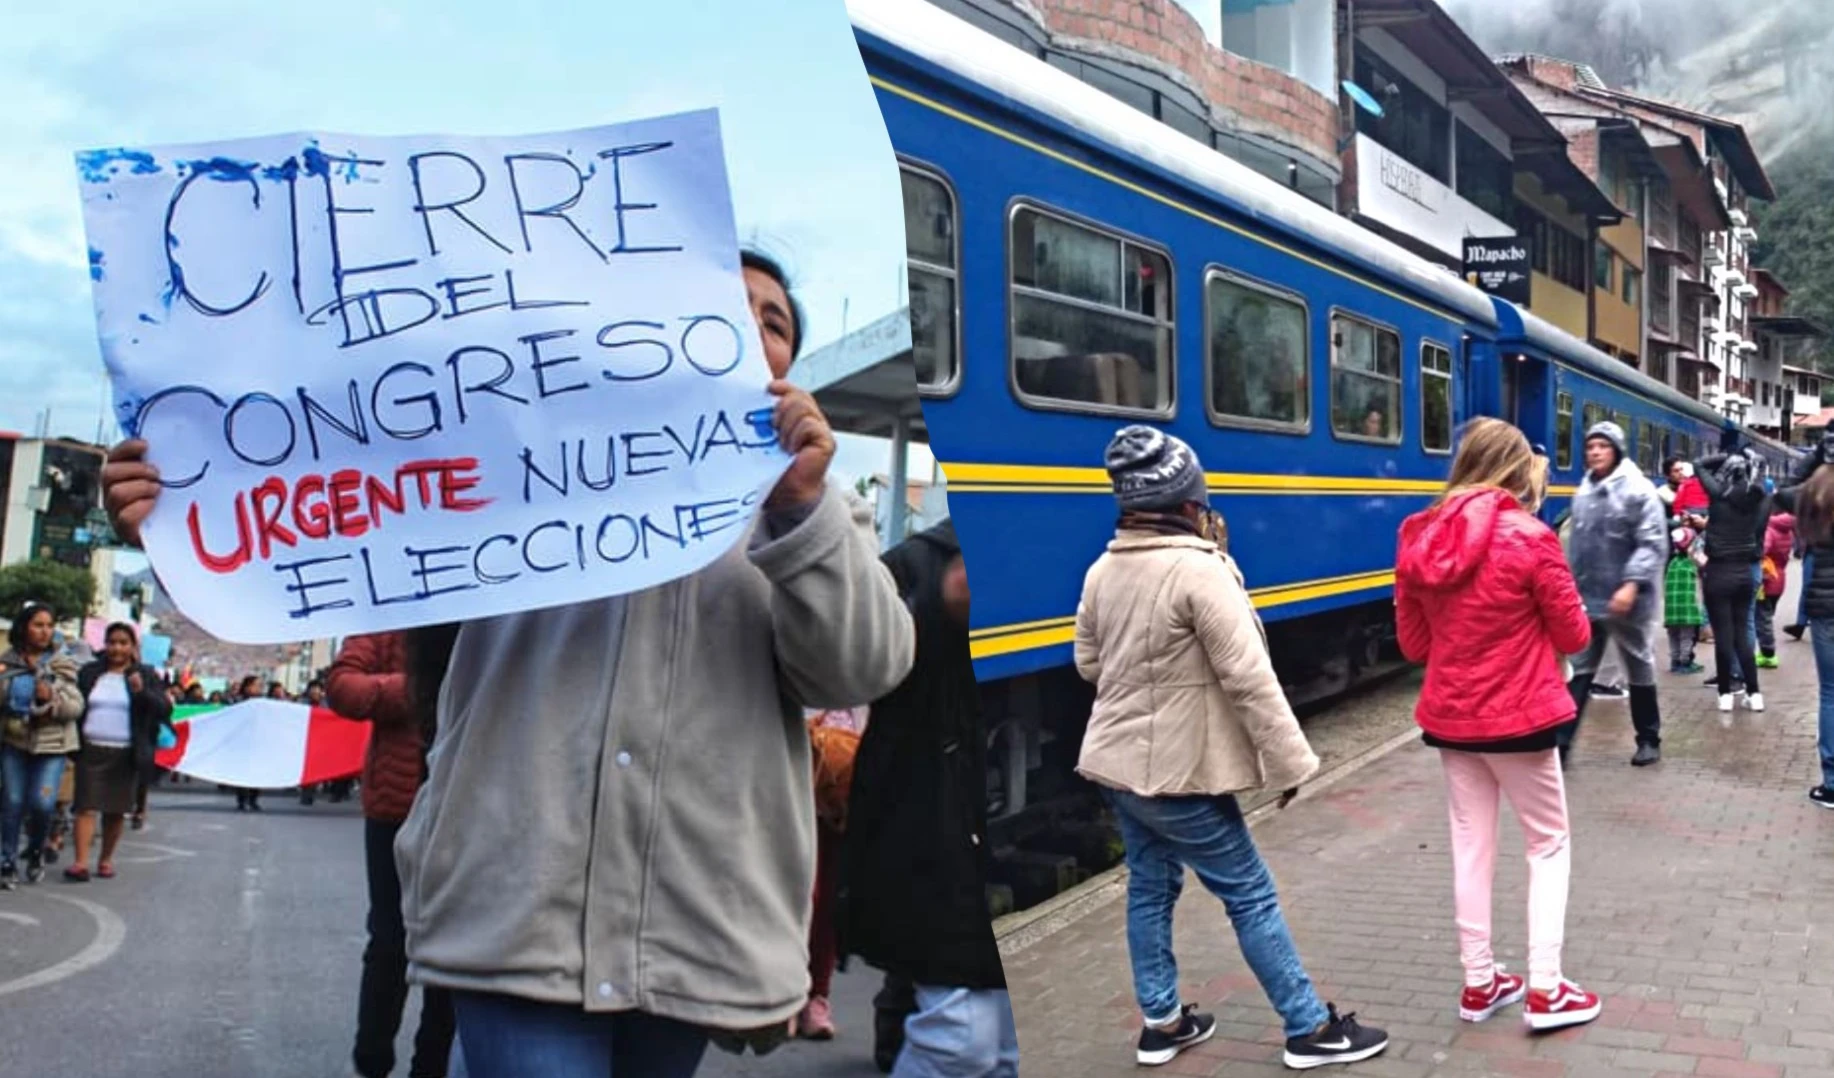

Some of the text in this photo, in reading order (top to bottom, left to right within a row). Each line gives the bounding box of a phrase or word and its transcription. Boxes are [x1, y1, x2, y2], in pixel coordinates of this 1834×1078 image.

[164, 140, 683, 316] CIERRE
[306, 269, 590, 348] DEL
[1466, 245, 1526, 263] Mapacho
[135, 314, 743, 488] CONGRESO
[187, 407, 779, 574] URGENTE NUEVAS
